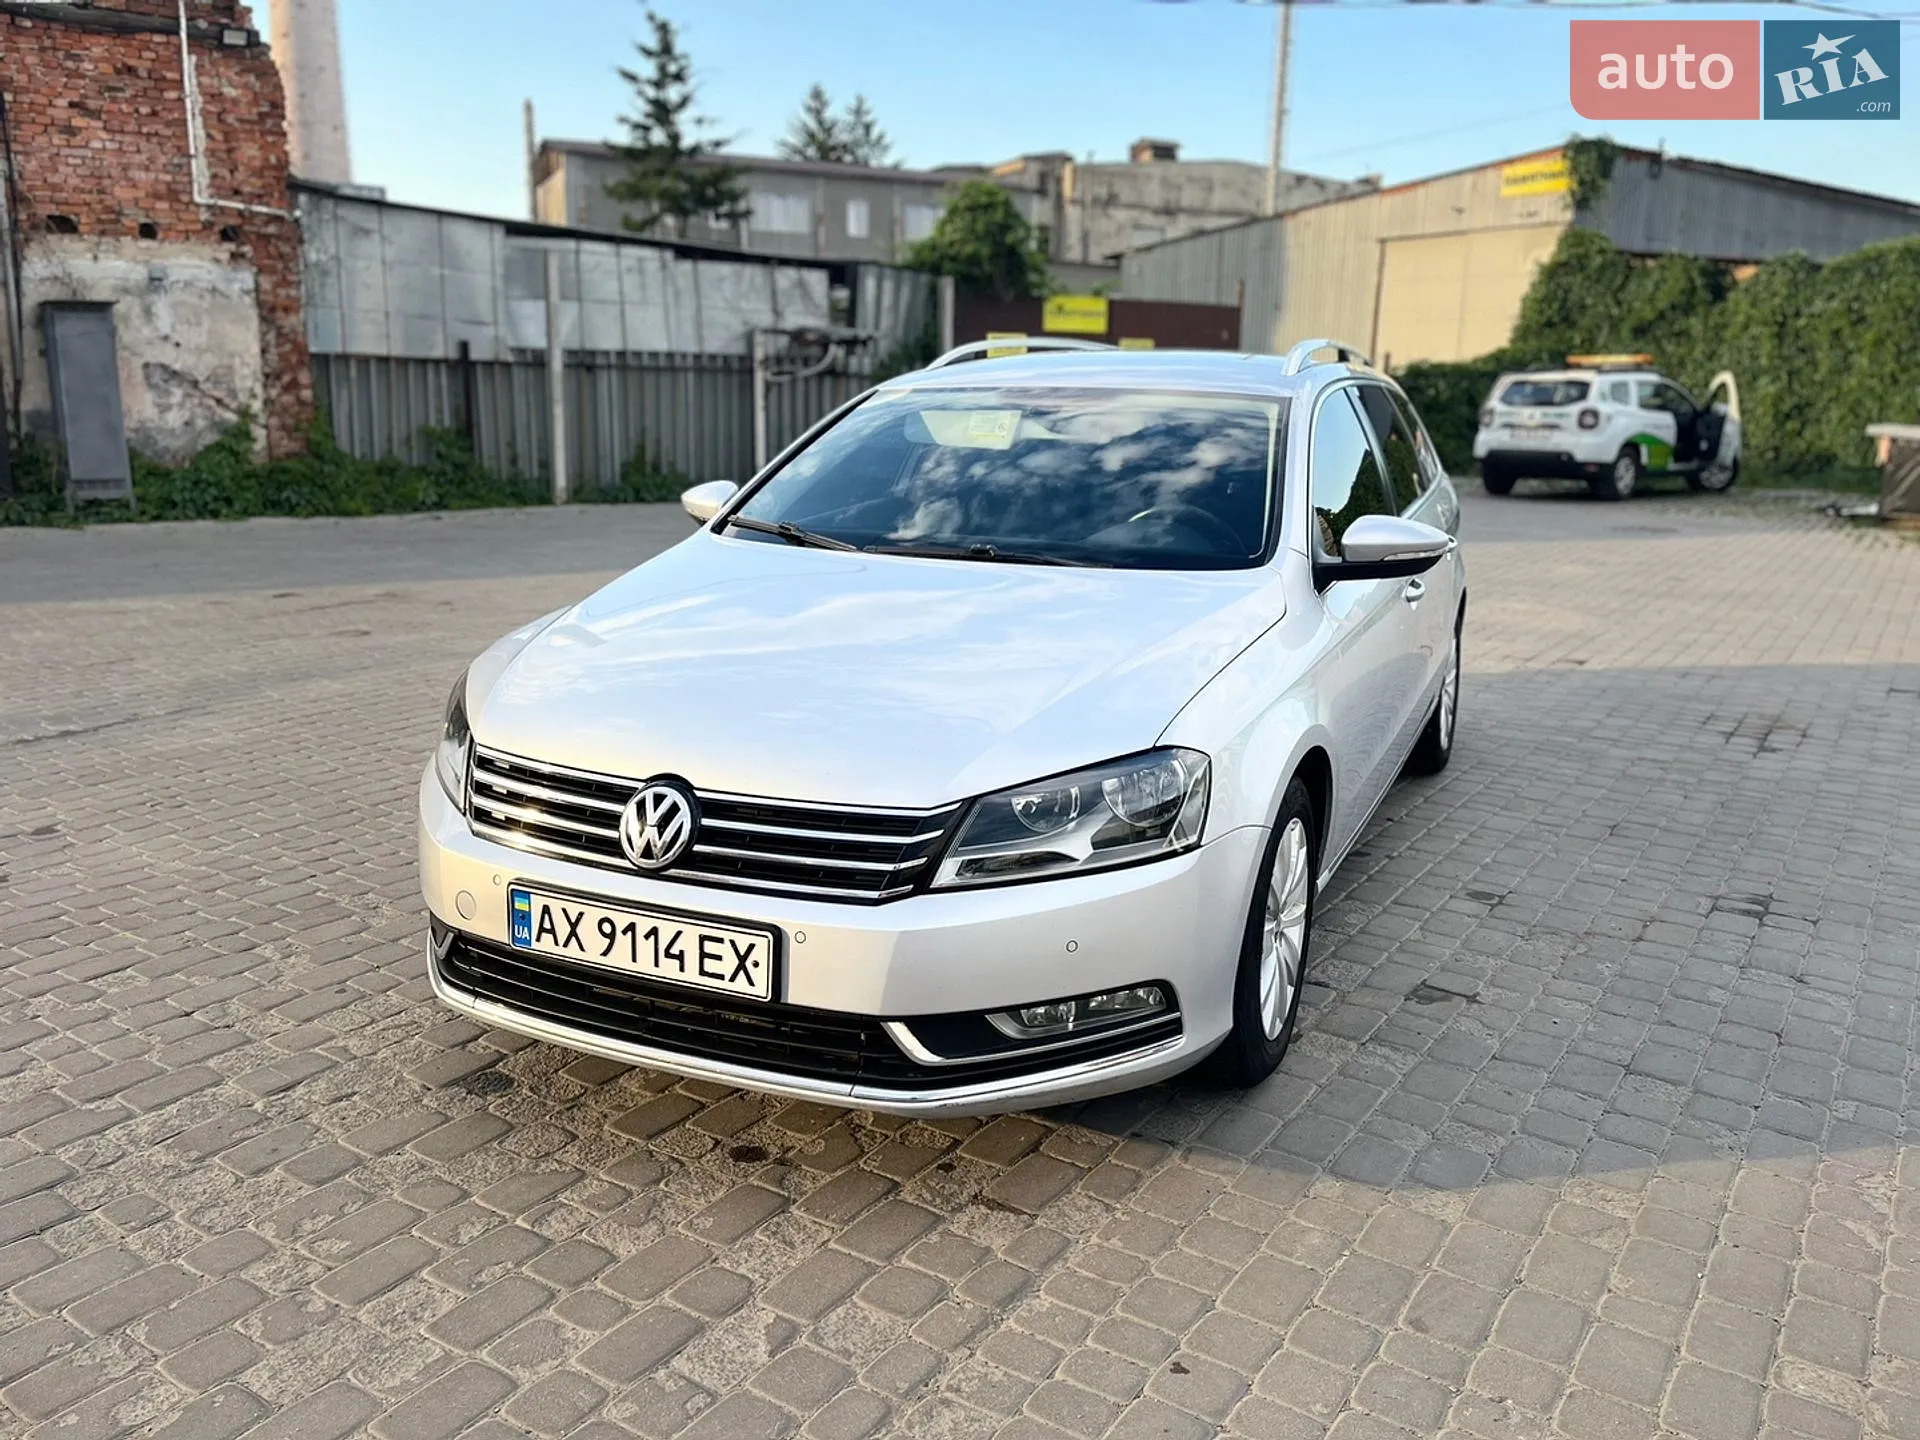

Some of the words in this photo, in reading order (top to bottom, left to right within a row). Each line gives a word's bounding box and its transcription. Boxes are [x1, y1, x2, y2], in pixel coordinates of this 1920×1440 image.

[514, 925, 530, 941] UA
[535, 903, 586, 953] AX
[597, 916, 685, 973] 9114
[698, 933, 757, 987] EX
